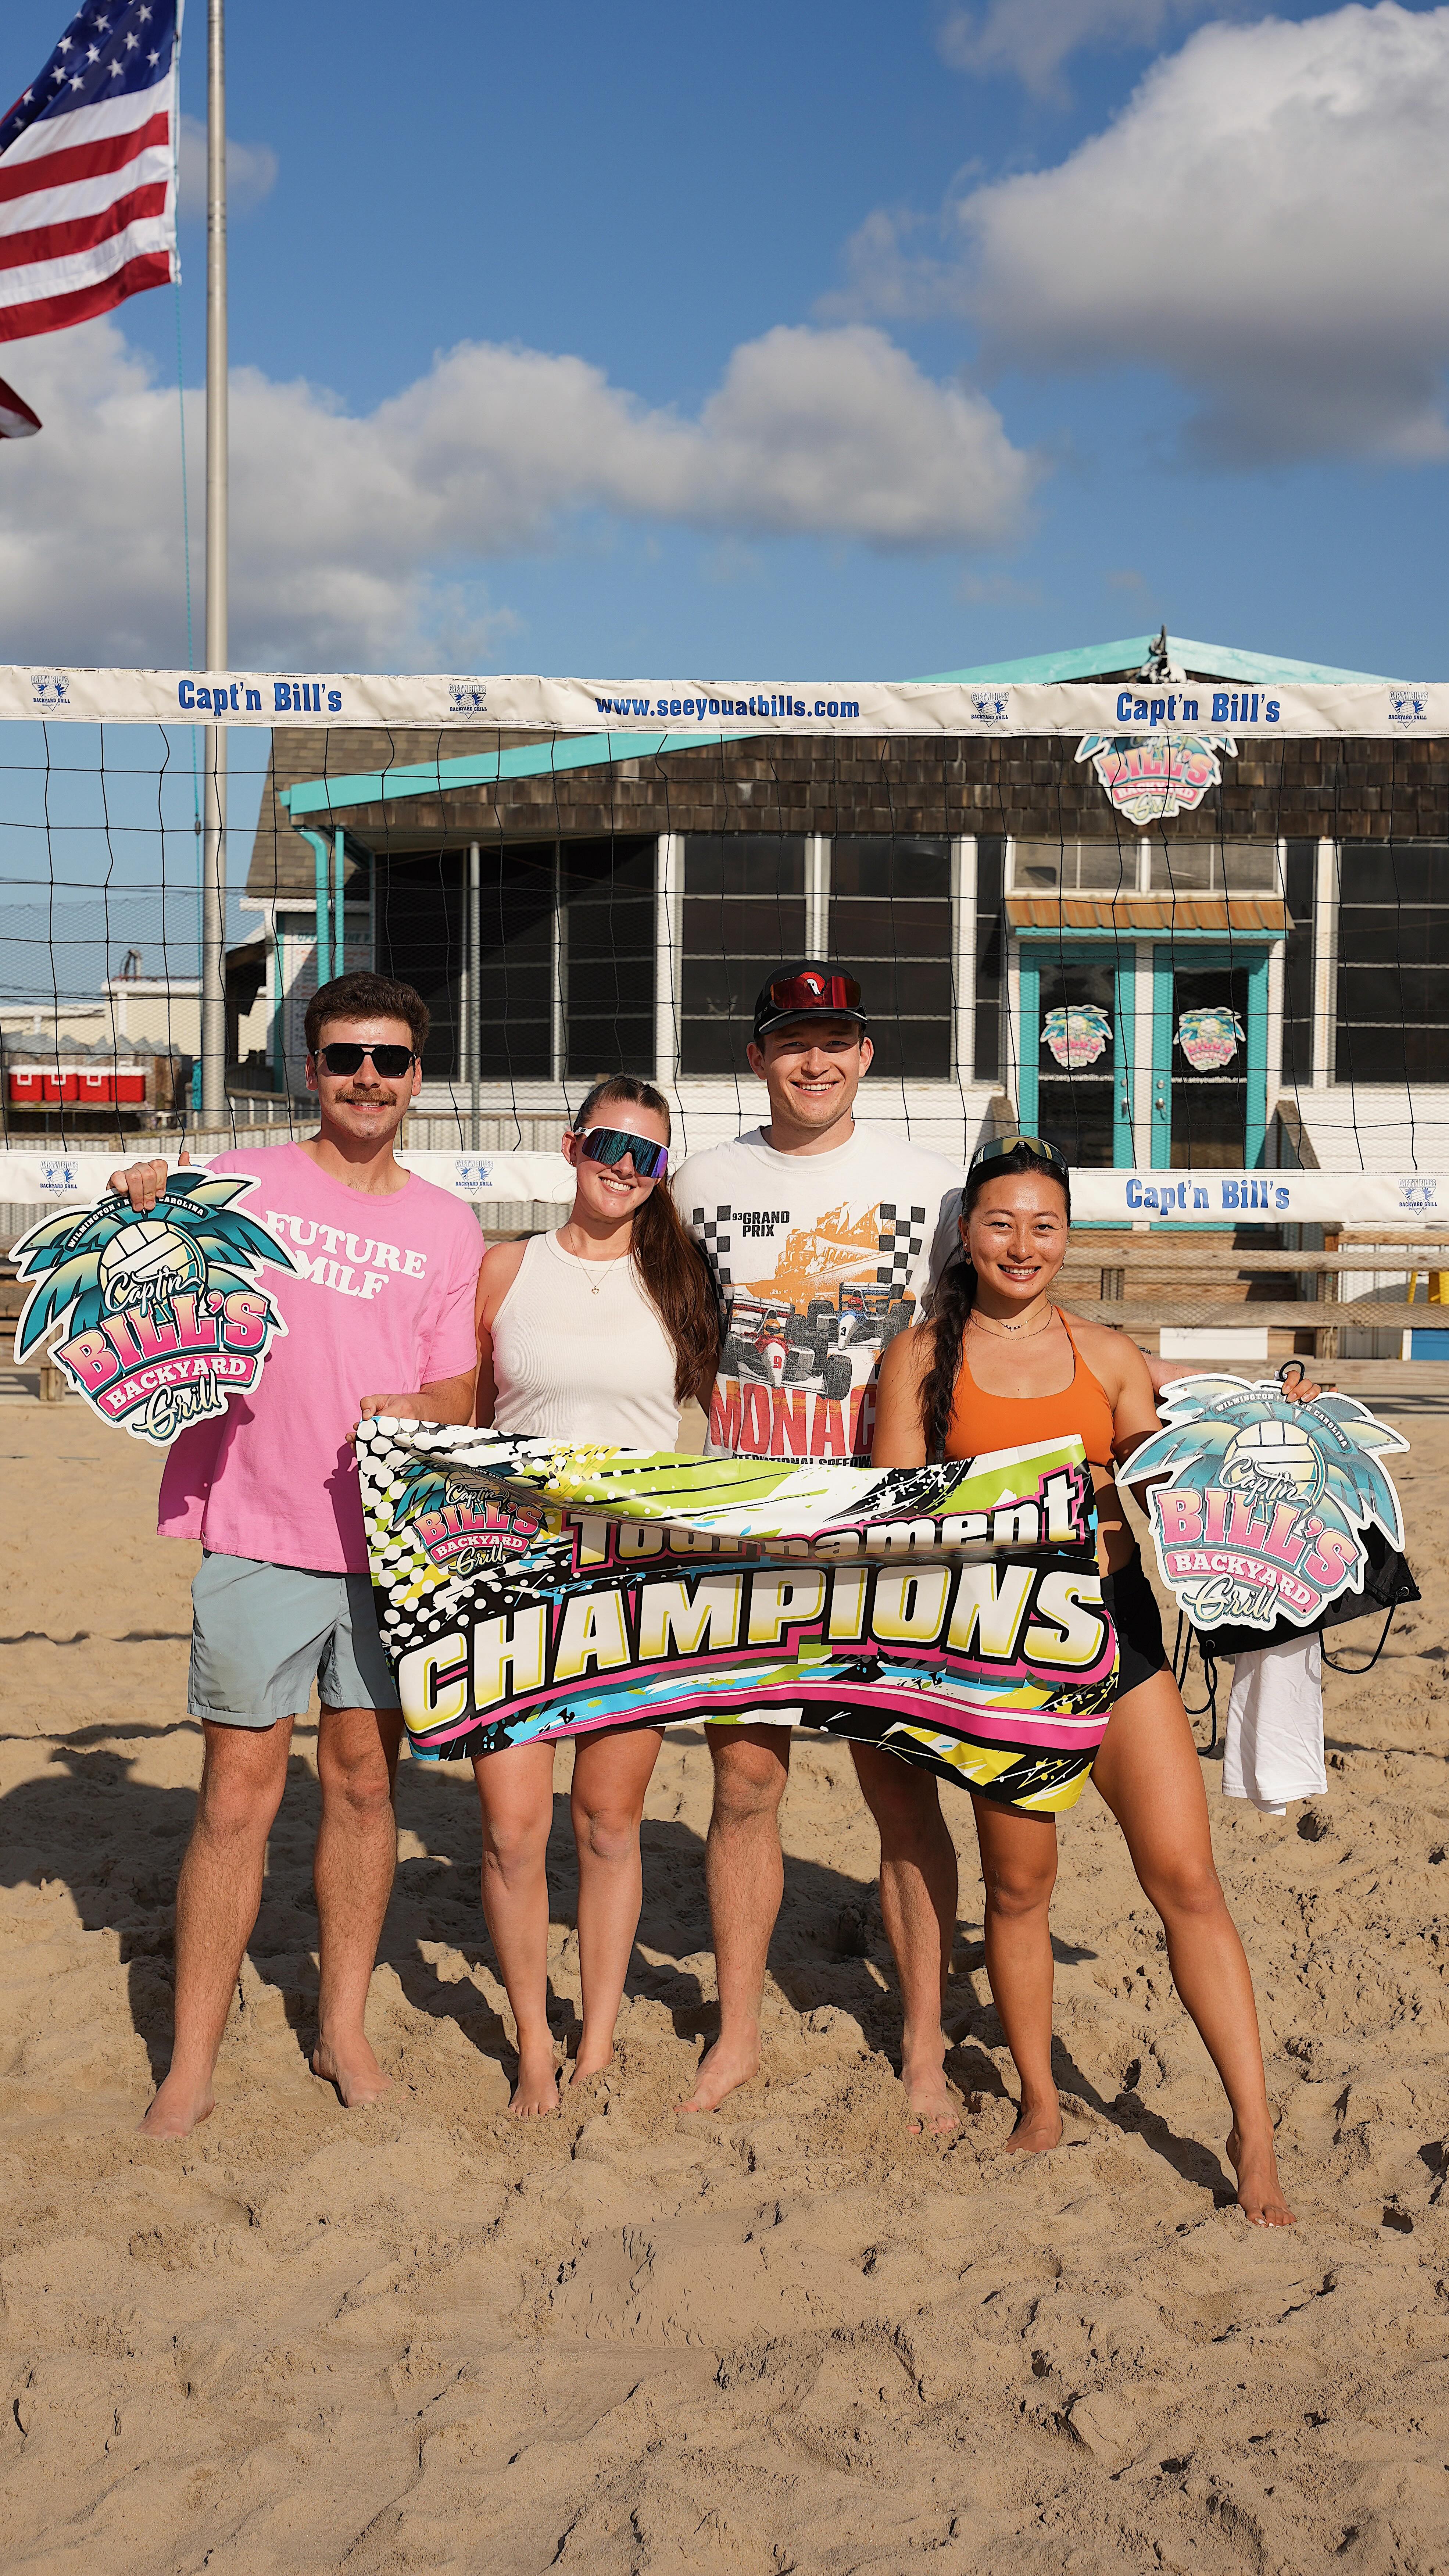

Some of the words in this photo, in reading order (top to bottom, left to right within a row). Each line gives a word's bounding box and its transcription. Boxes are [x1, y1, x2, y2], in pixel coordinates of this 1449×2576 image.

[31, 675, 50, 683] CAPT'N
[52, 675, 69, 684] BILL'S
[449, 684, 468, 693] CAPT'N
[972, 693, 991, 701] CAPT'N
[992, 692, 1009, 700] BILL'S
[1390, 691, 1410, 700] CAPT'N
[1410, 691, 1428, 700] BILL'S
[178, 680, 261, 716] Capt'n
[274, 682, 342, 712] Bill's
[595, 695, 859, 721] www.seeyouatbills.com
[1116, 692, 1198, 726] Capt'n
[1211, 693, 1280, 722] Bill's
[1099, 747, 1213, 784] BILL'S
[41, 1160, 61, 1169] CAPT'N
[61, 1161, 78, 1170] BILL'S
[1399, 1179, 1418, 1187] CAPT'N
[1419, 1179, 1436, 1187] BILL'S
[1126, 1179, 1209, 1215] Capt'n
[1222, 1180, 1289, 1209] Bill's
[68, 1205, 115, 1248] WILMINGTON
[743, 1211, 790, 1224] GRAND
[743, 1224, 774, 1237] PRIX
[265, 1210, 427, 1280] FUTURE
[105, 1266, 201, 1317] Capt'n
[295, 1250, 390, 1299] MILF
[60, 1290, 269, 1394] BILL'S
[841, 1327, 847, 1336] 3
[773, 1355, 782, 1368] 9
[106, 1358, 247, 1410] BACKYARD
[133, 1369, 221, 1439] Grill
[709, 1379, 877, 1456] MONAC
[1216, 1393, 1274, 1412] WILMINGTON
[1314, 1410, 1348, 1447] CAROLINA
[446, 1484, 506, 1507] Capt'n
[489, 1473, 515, 1487] CAROLINA
[1219, 1455, 1313, 1507] Capt'n
[414, 1500, 543, 1546] BILL'S
[570, 1475, 1078, 1566] Tournament
[1157, 1488, 1357, 1587] BILL'S
[436, 1535, 523, 1558] BACKYARD
[448, 1542, 504, 1575] Grill
[1174, 1553, 1311, 1606] BACKYARD
[1183, 1574, 1280, 1622] Grill
[398, 1564, 1104, 1734] CHAMPIONS
